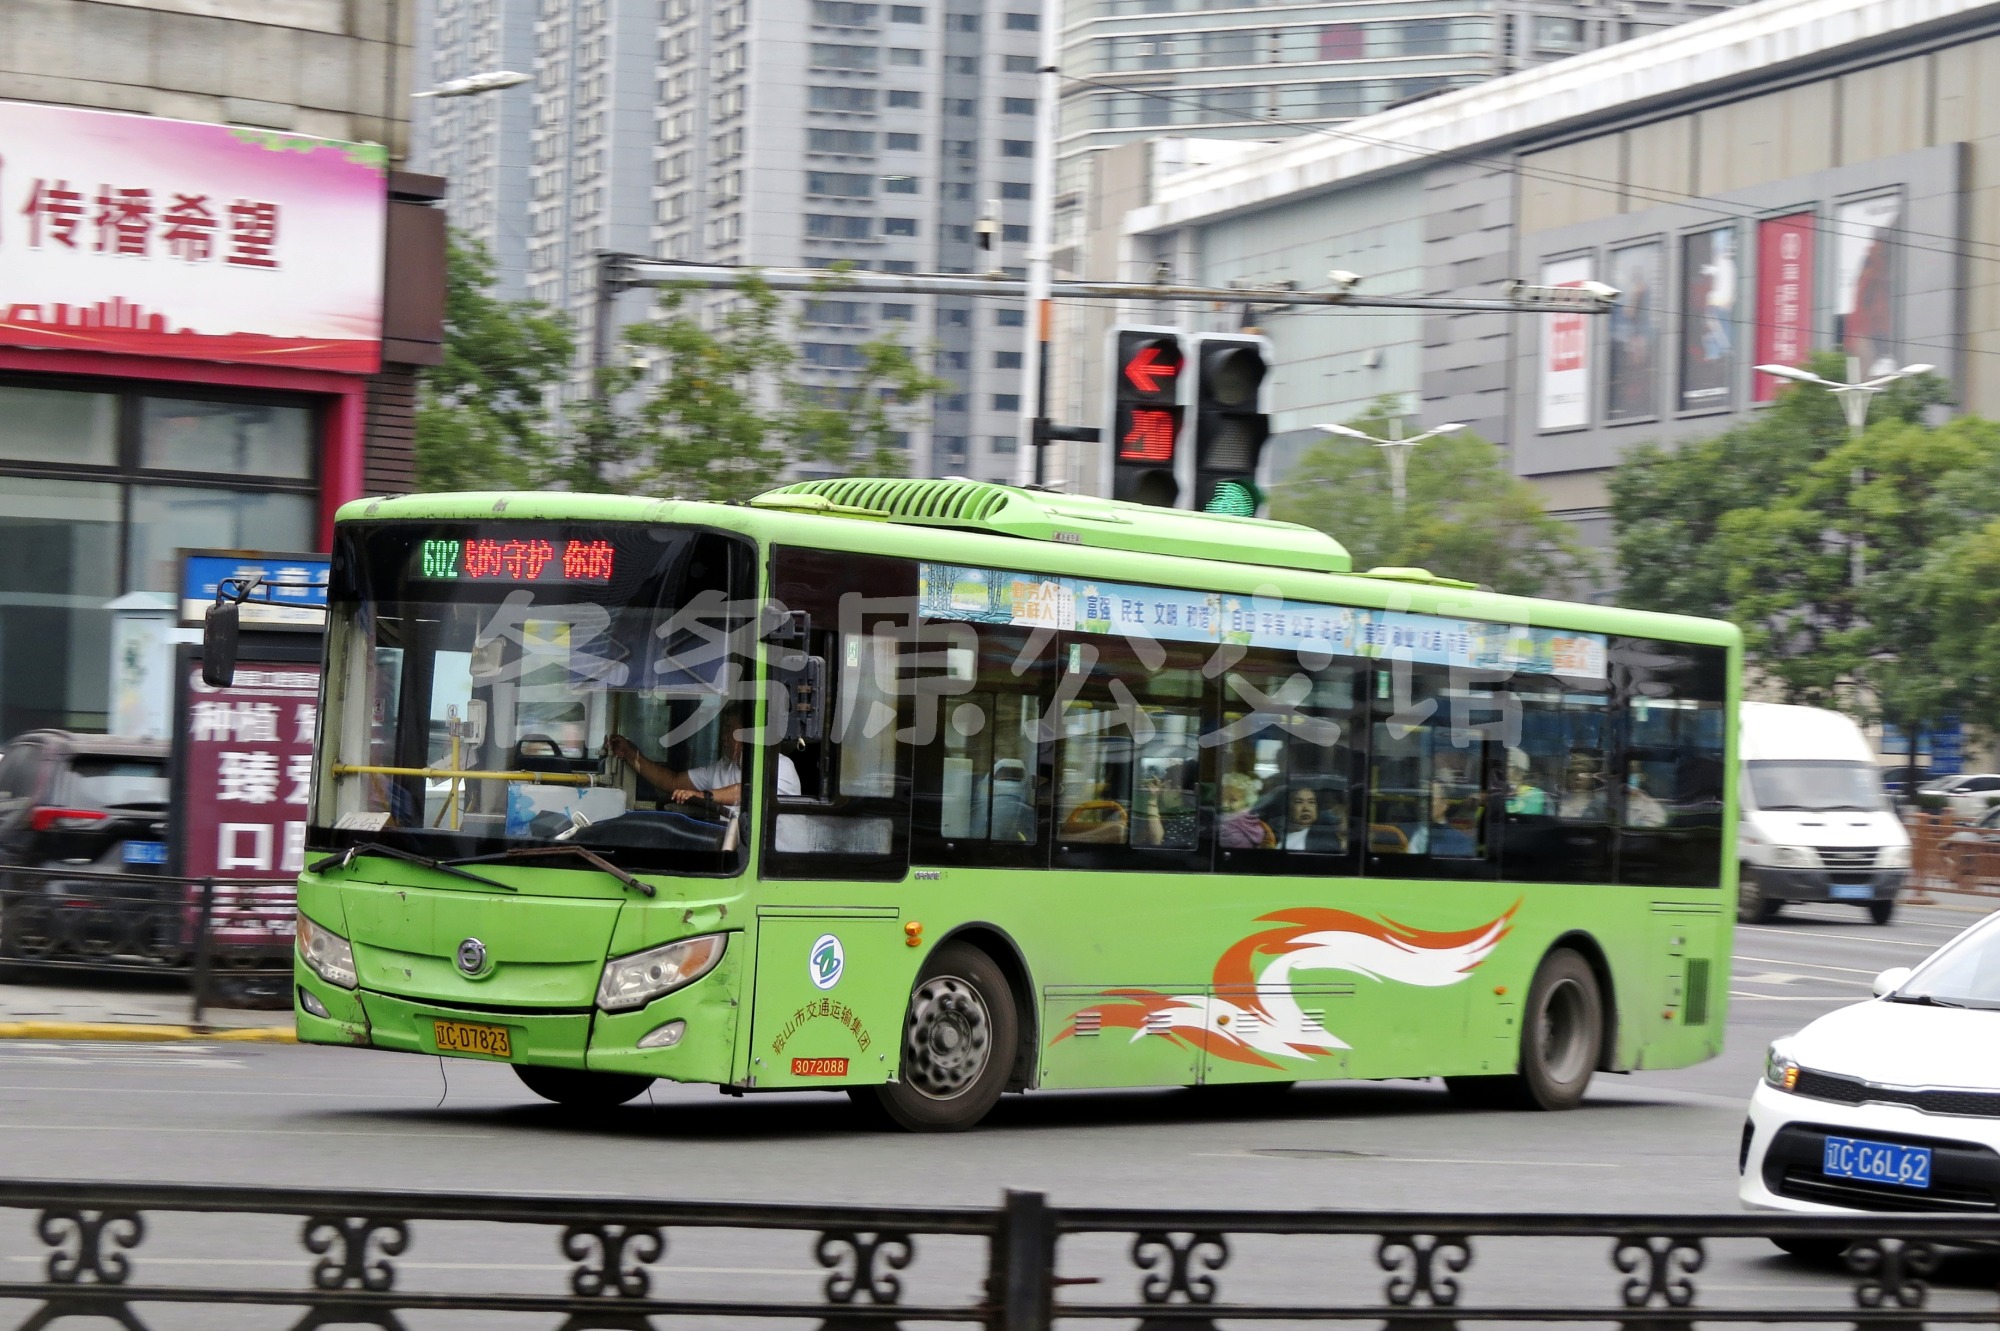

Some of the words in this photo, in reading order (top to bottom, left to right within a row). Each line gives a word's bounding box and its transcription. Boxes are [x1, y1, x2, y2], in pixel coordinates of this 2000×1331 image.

[22, 177, 283, 270] 传播希望
[424, 540, 459, 577] 602
[563, 540, 615, 578] 你的
[1012, 601, 1055, 621] 吉祥人
[1087, 595, 1111, 620] 富强
[1121, 599, 1144, 624] 民主
[1154, 602, 1178, 626] 文明
[1262, 612, 1286, 636] 平等
[189, 701, 283, 742] 种植
[772, 998, 871, 1055] 鞍山市交通运输集团
[795, 1060, 844, 1074] 3072088
